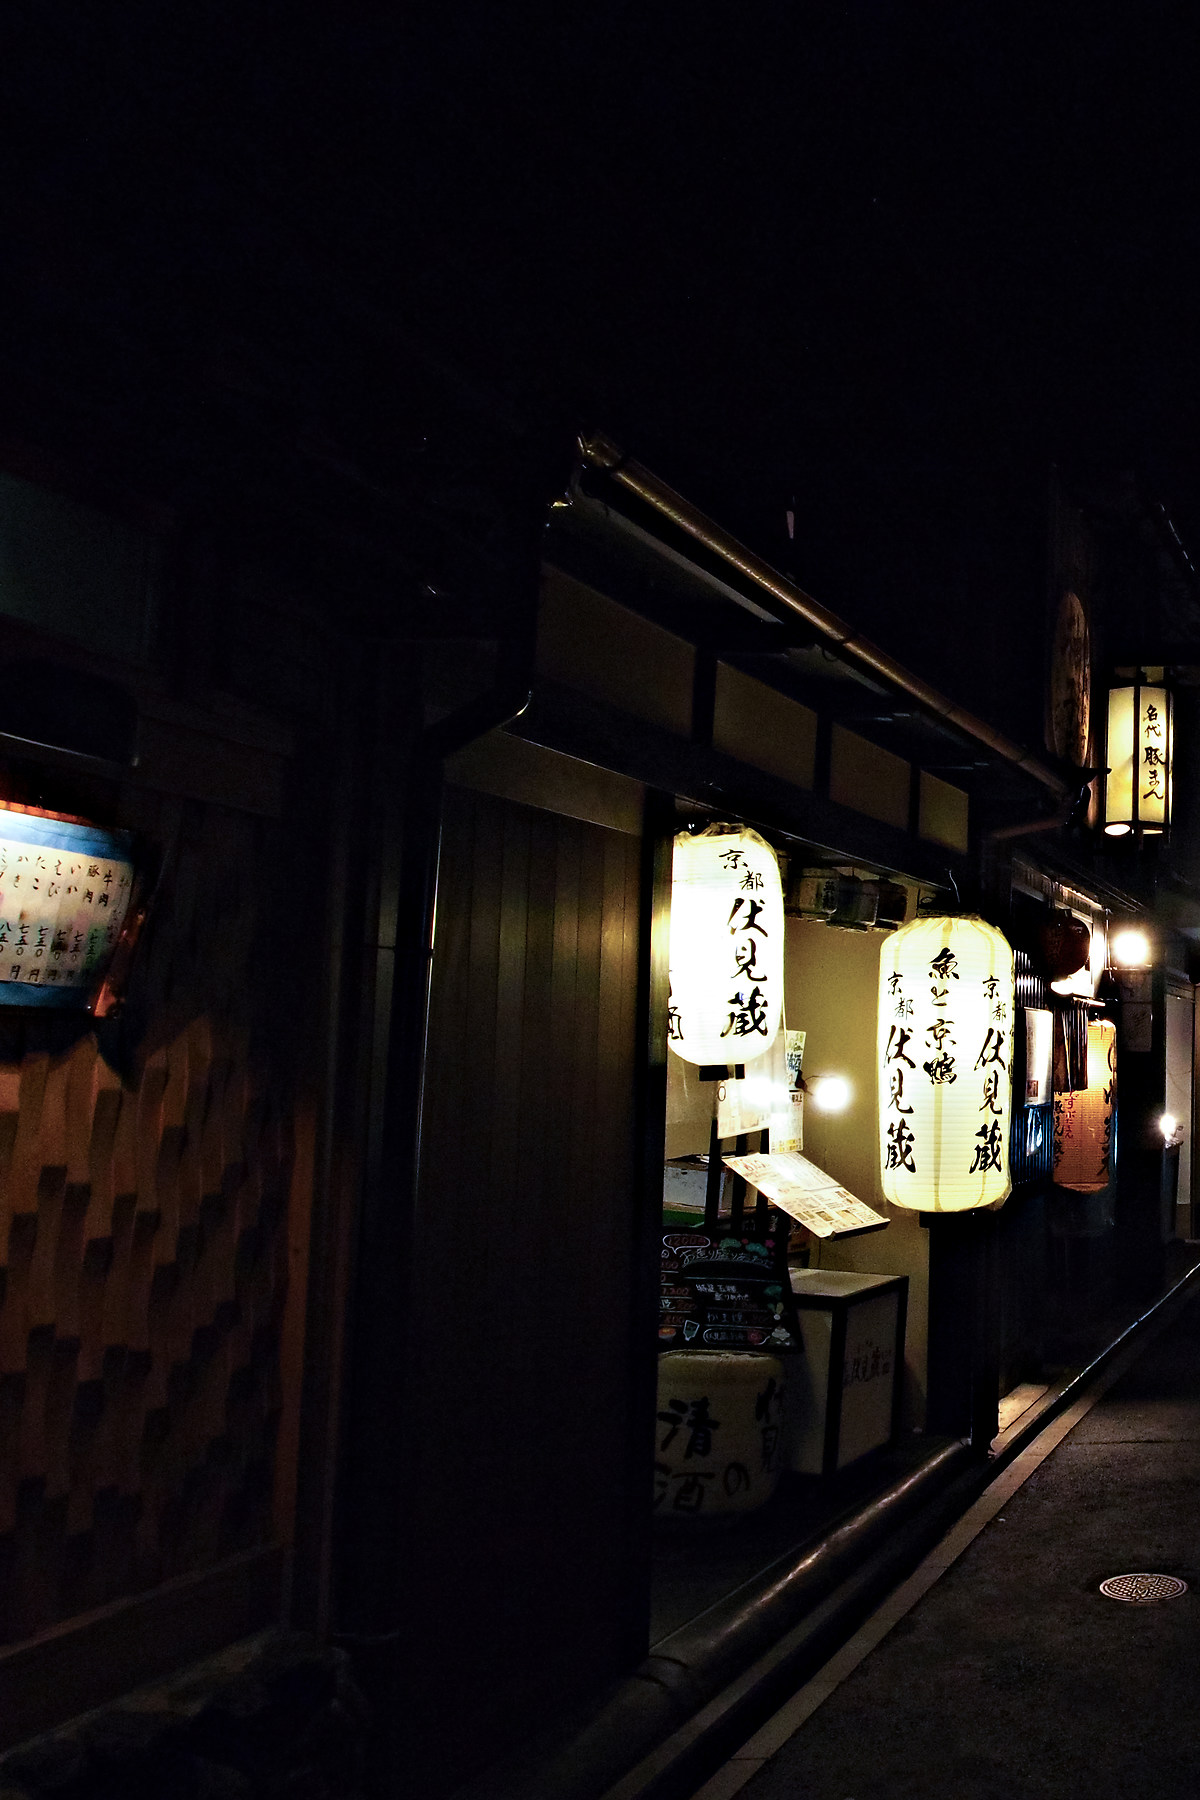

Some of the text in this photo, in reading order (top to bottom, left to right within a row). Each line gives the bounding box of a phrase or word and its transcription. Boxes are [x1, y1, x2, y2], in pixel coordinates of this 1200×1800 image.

[1143, 704, 1165, 800] 名代 豚まん
[33, 856, 46, 890] たこ
[48, 860, 62, 897] えび
[84, 865, 100, 904] 豚肉
[720, 898, 768, 1037] 伏見蔵
[883, 1025, 917, 1173] 伏見蔵
[969, 1028, 1008, 1174] 伏見蔵
